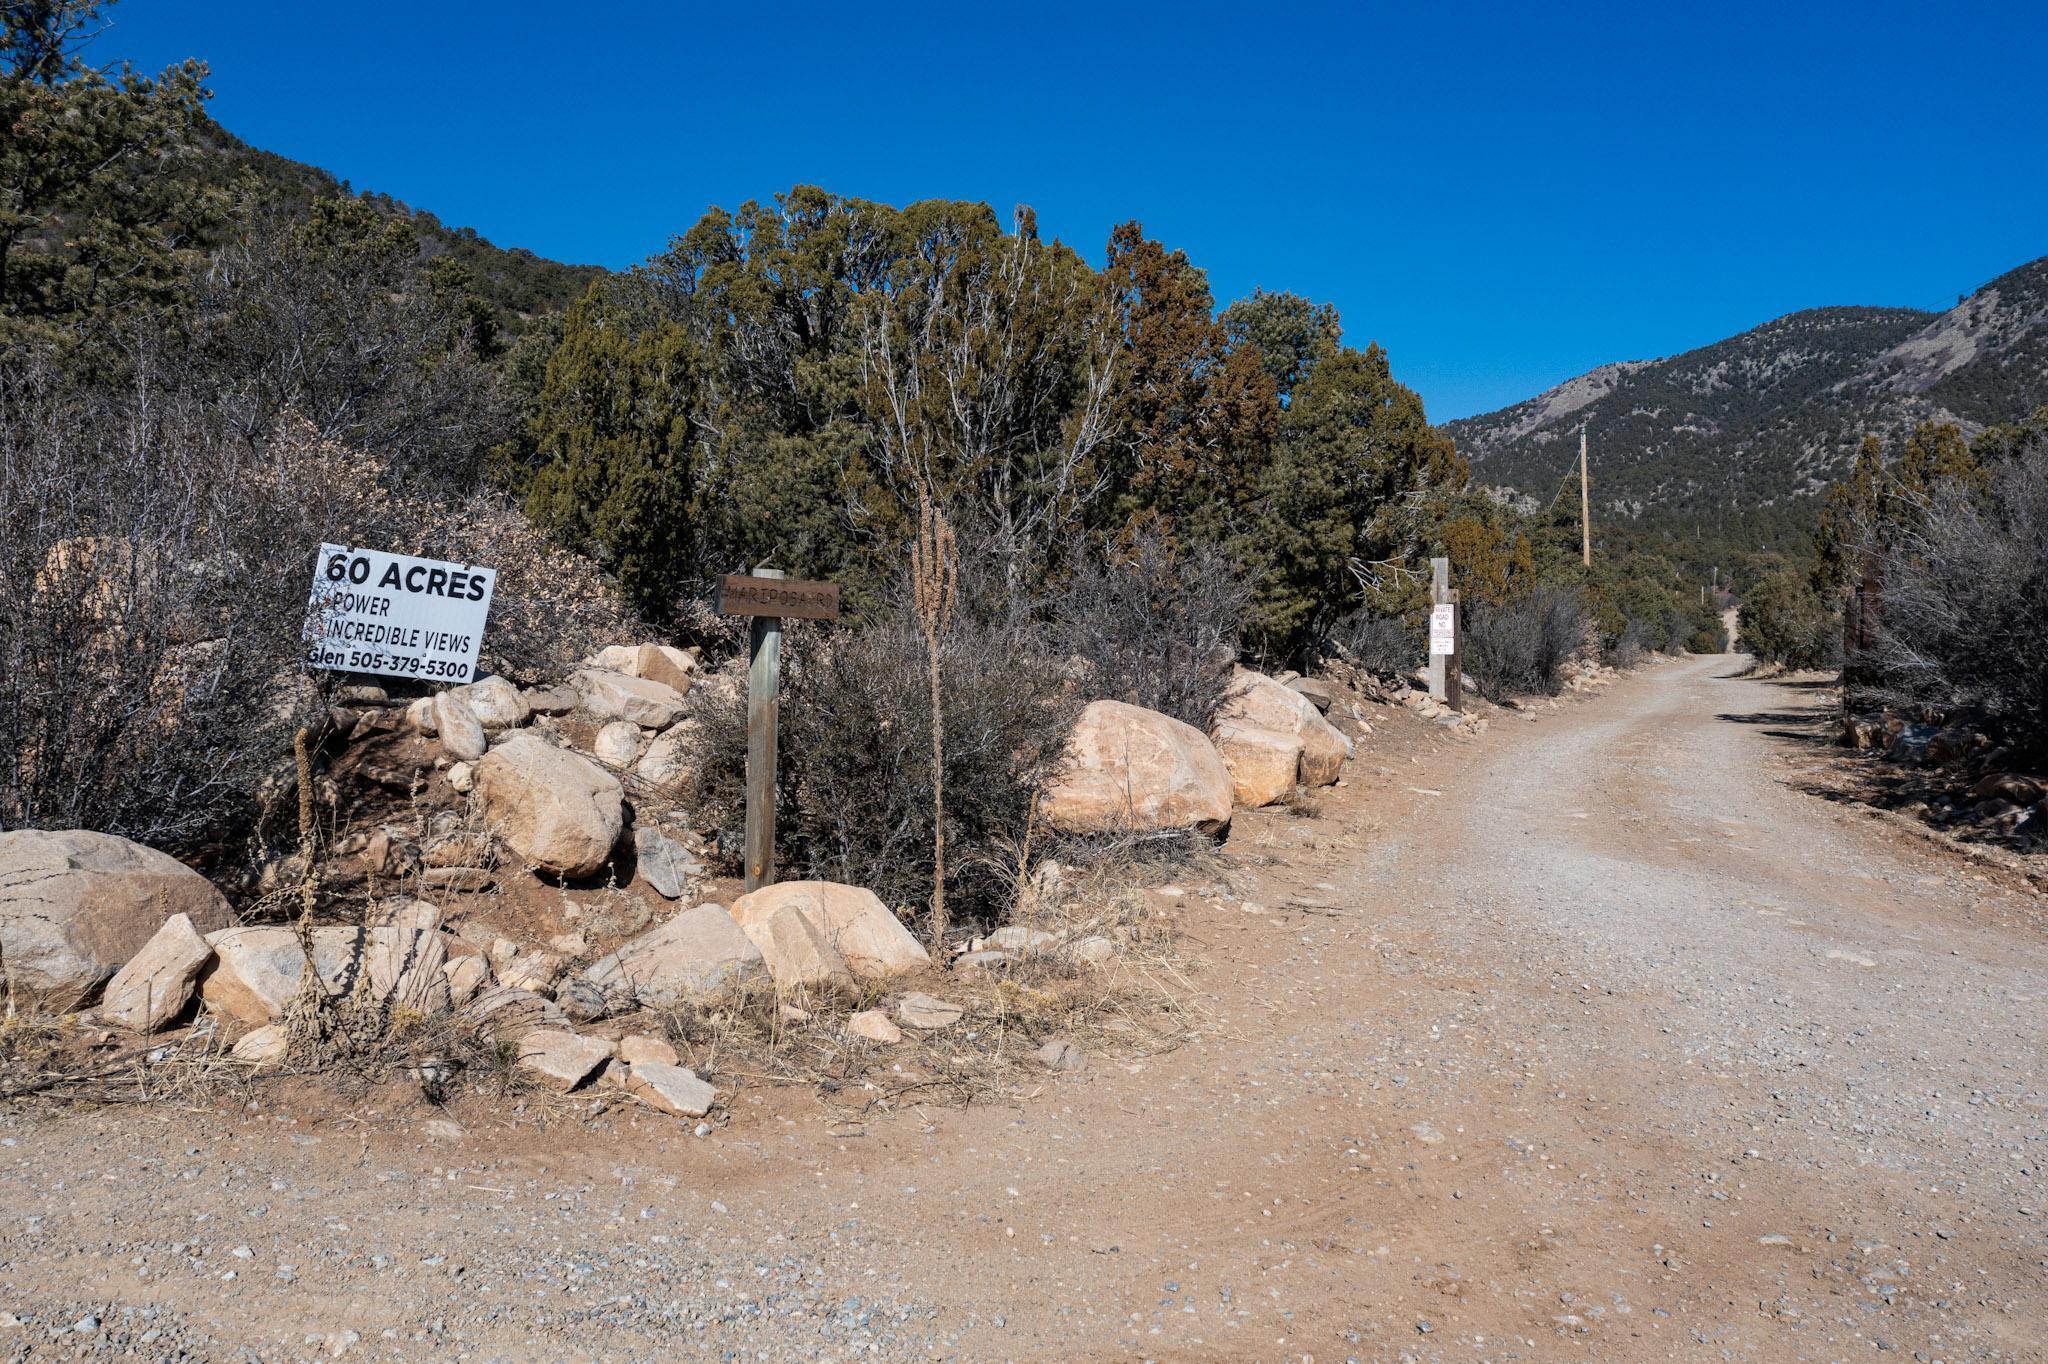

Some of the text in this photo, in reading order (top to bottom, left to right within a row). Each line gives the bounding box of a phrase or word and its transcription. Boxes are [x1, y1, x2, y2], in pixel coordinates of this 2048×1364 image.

[326, 553, 487, 601] 60 ACRES
[333, 591, 390, 617] POWER
[326, 619, 471, 654] INCREDIBLE VIEWS
[308, 646, 468, 679] Glen 505-379-5300
